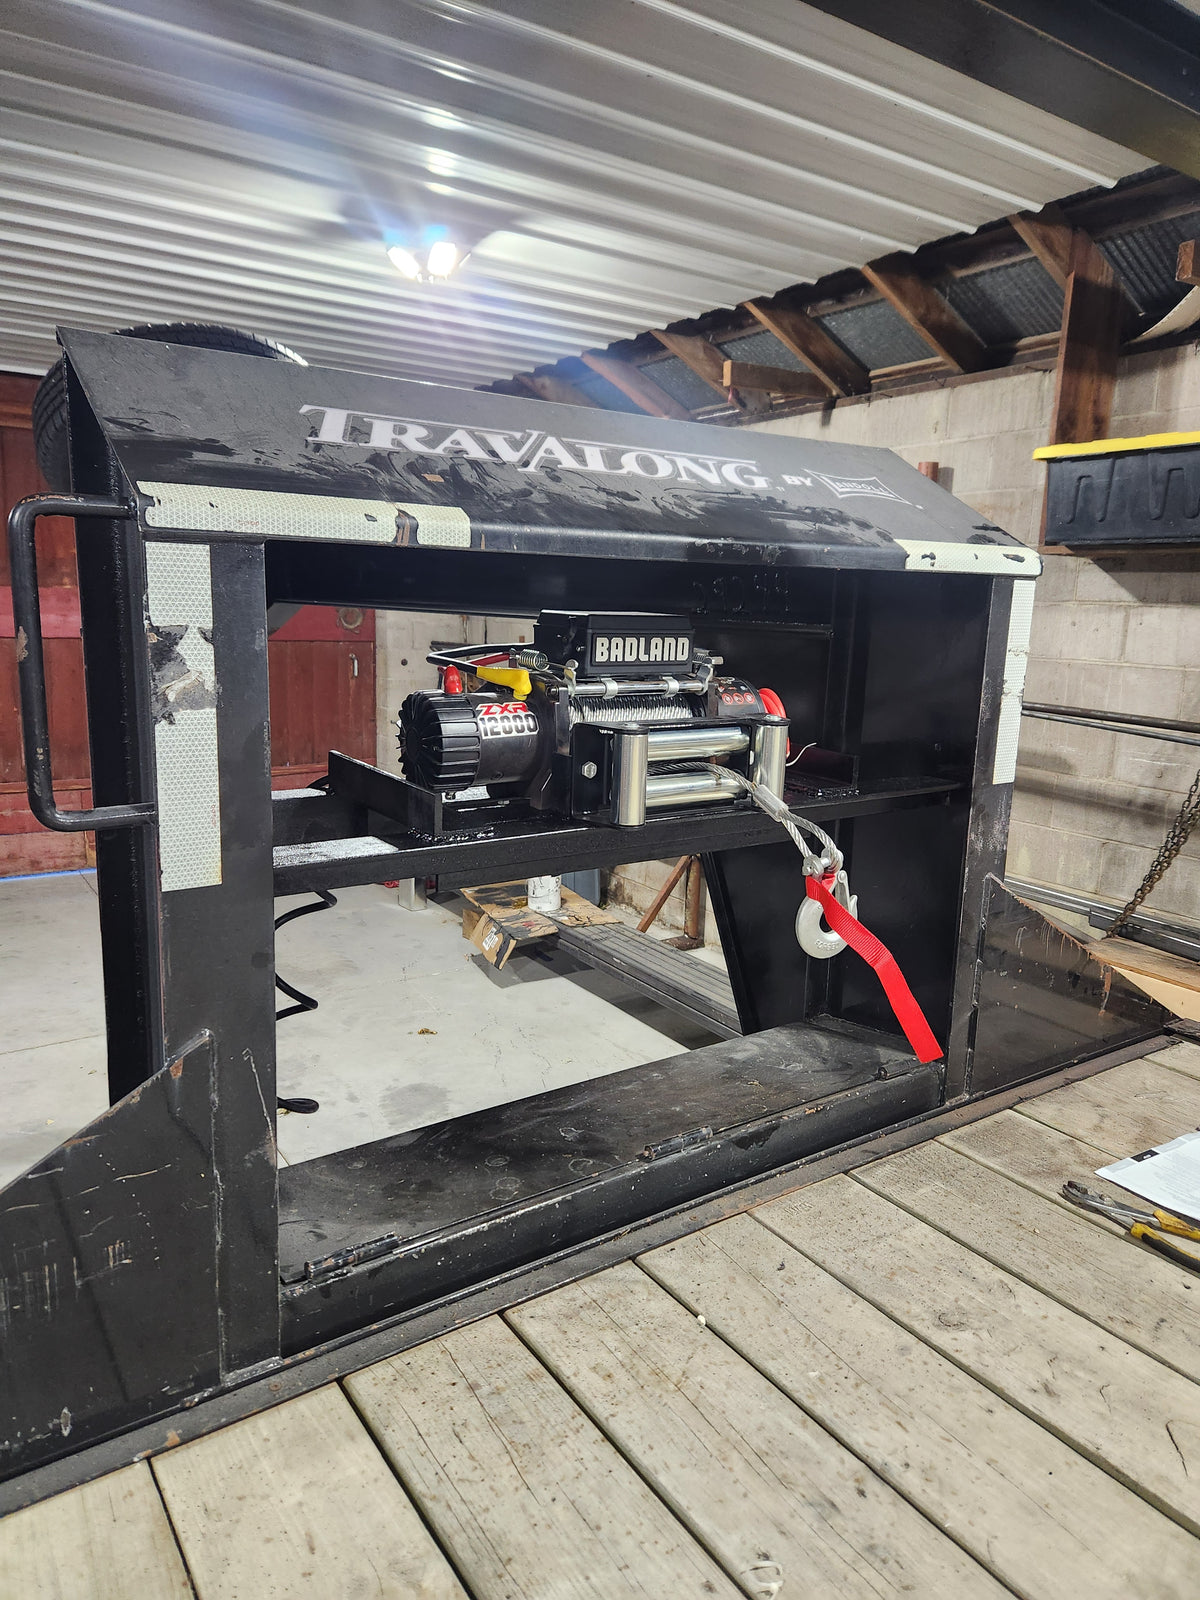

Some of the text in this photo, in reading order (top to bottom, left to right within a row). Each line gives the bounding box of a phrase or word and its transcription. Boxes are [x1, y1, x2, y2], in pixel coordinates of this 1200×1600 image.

[299, 404, 769, 489] TRAVALONG
[781, 474, 813, 486] BY
[595, 637, 690, 662] BADLAND
[480, 702, 529, 716] ZXR
[479, 713, 538, 737] 12000
